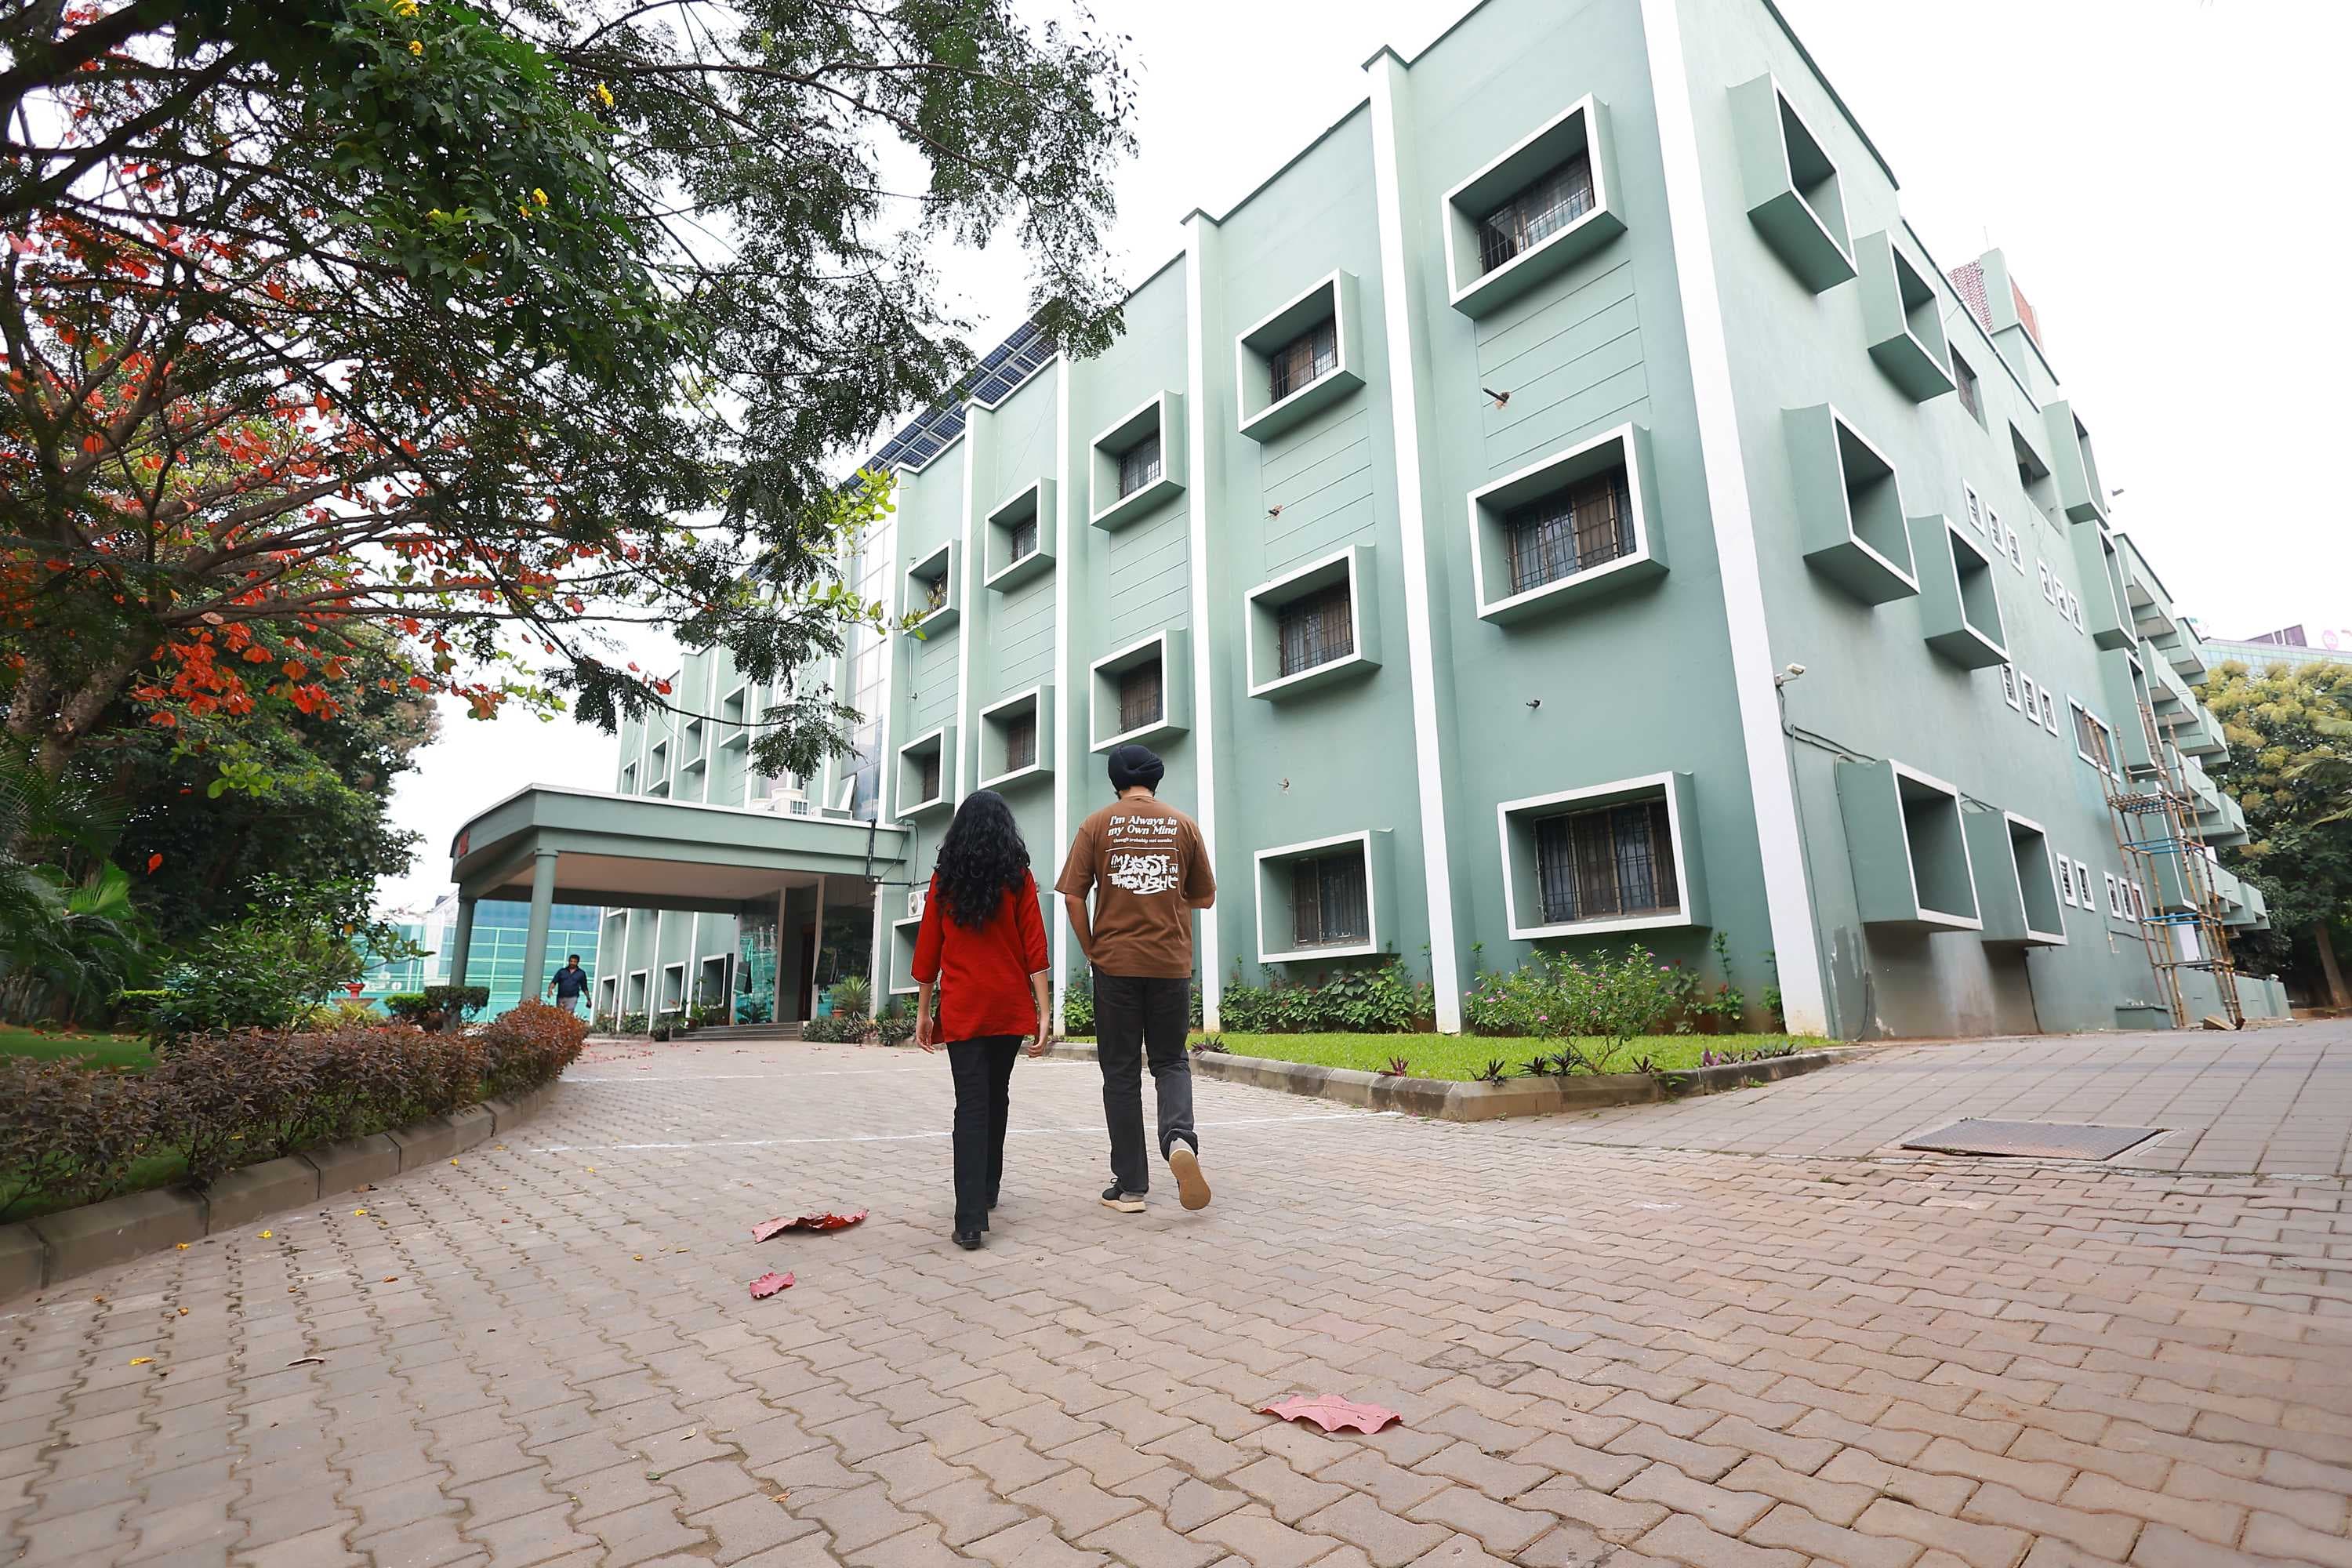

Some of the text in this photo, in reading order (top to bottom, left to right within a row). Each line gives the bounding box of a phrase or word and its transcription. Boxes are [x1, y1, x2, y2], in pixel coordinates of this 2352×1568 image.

[1109, 815, 1177, 826] I'm Always in
[1108, 825, 1178, 836] my Own Mind
